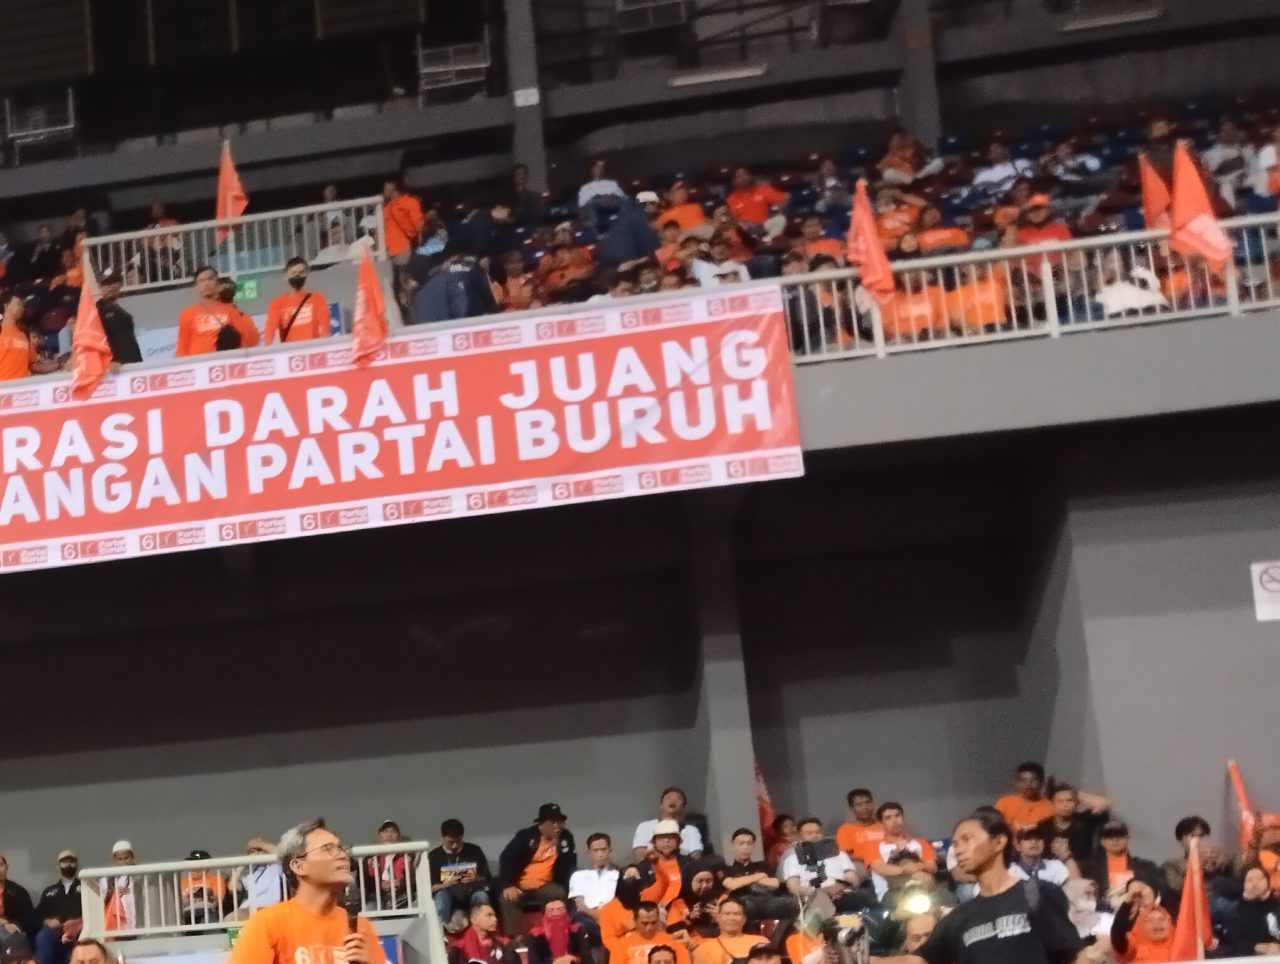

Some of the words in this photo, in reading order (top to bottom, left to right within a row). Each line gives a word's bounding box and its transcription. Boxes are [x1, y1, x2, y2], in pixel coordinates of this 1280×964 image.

[623, 312, 637, 327] 6
[538, 323, 551, 339] 6
[455, 334, 468, 349] 6
[291, 356, 303, 371] 6
[211, 367, 224, 382] 6
[133, 378, 146, 392] 6
[206, 371, 460, 448] DARAH
[500, 330, 769, 408] JUANG
[54, 388, 68, 401] 6
[247, 415, 496, 494] PARTAI
[516, 380, 772, 461] BURUH
[641, 473, 655, 488] 6
[555, 484, 568, 498] 6
[470, 494, 482, 509] 6
[385, 504, 398, 520] 6
[302, 514, 315, 530] 6
[221, 525, 234, 539] 6
[142, 535, 154, 549] 6
[63, 544, 75, 559] 6
